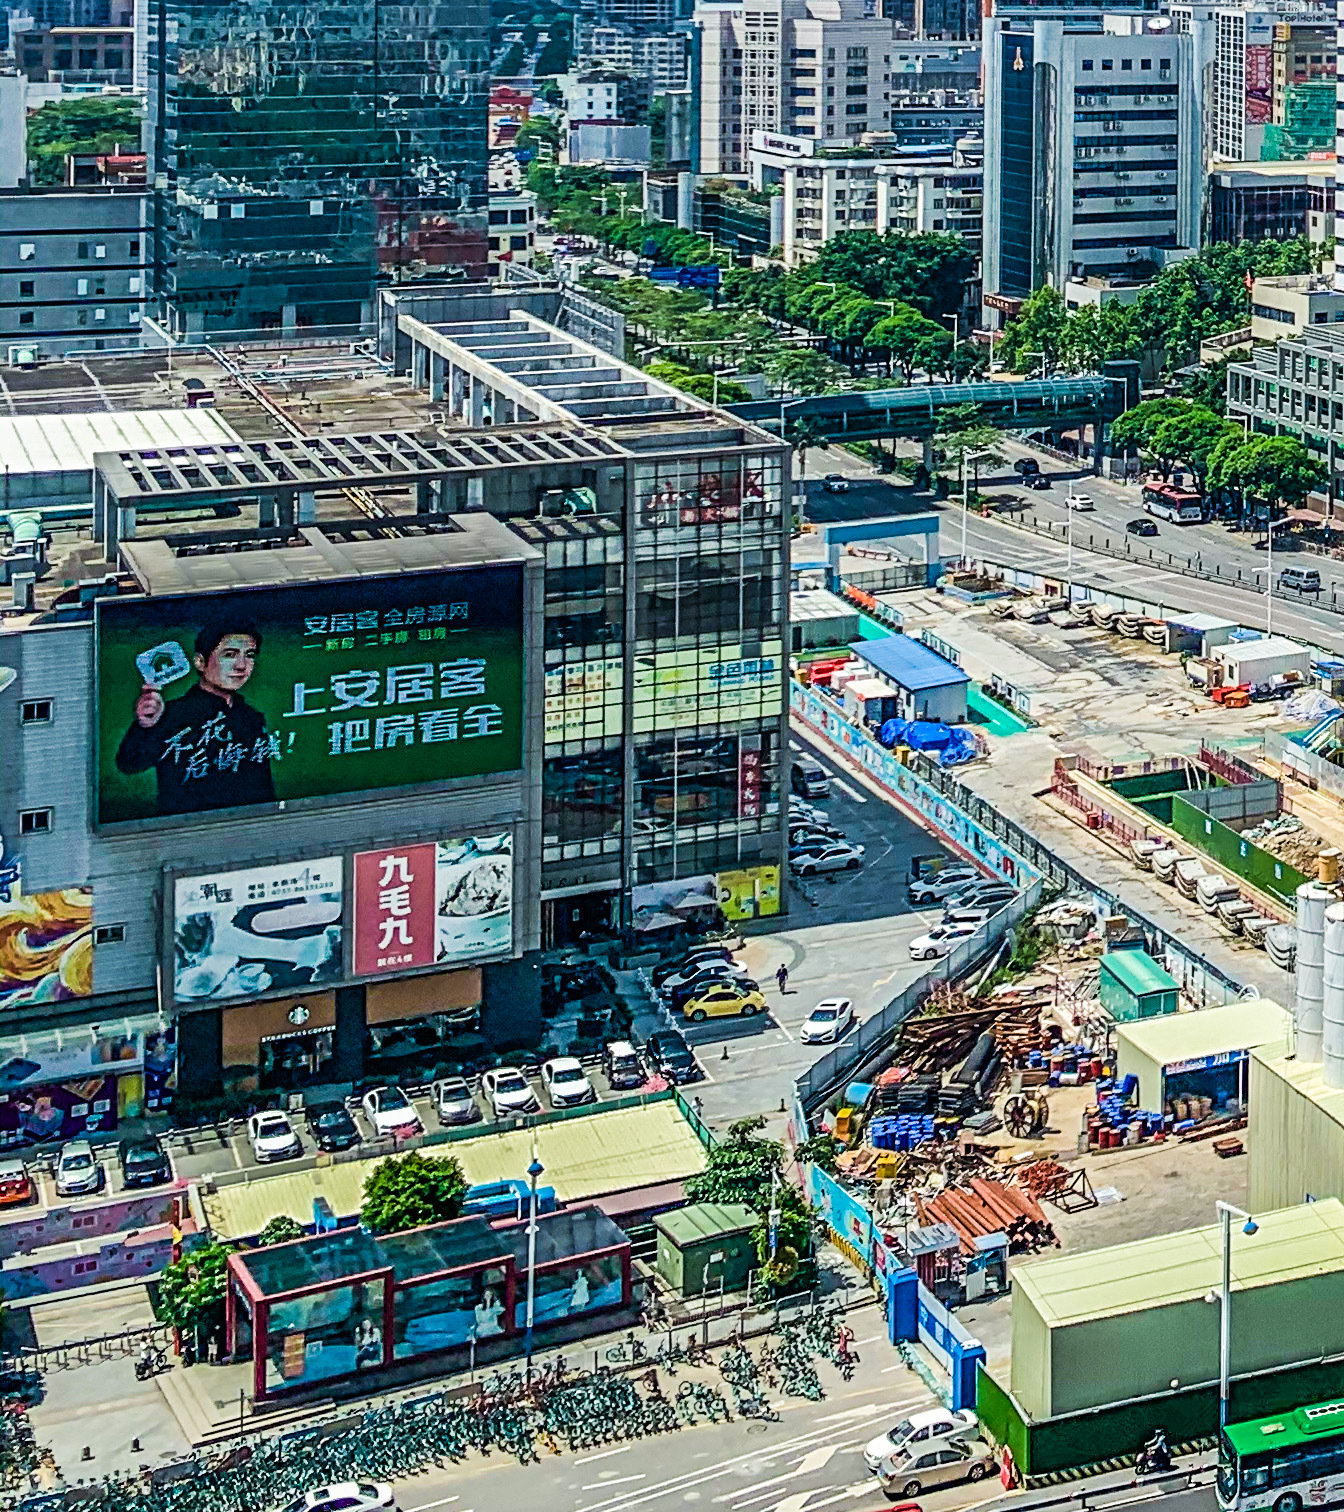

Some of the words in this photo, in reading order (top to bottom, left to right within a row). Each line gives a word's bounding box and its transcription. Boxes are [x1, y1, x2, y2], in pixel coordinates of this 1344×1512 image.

[304, 610, 379, 635] 安居客
[383, 601, 469, 627] 全房源网
[283, 658, 487, 717] 上安居客
[328, 704, 503, 756] 把房看全
[378, 854, 414, 950] 九毛九
